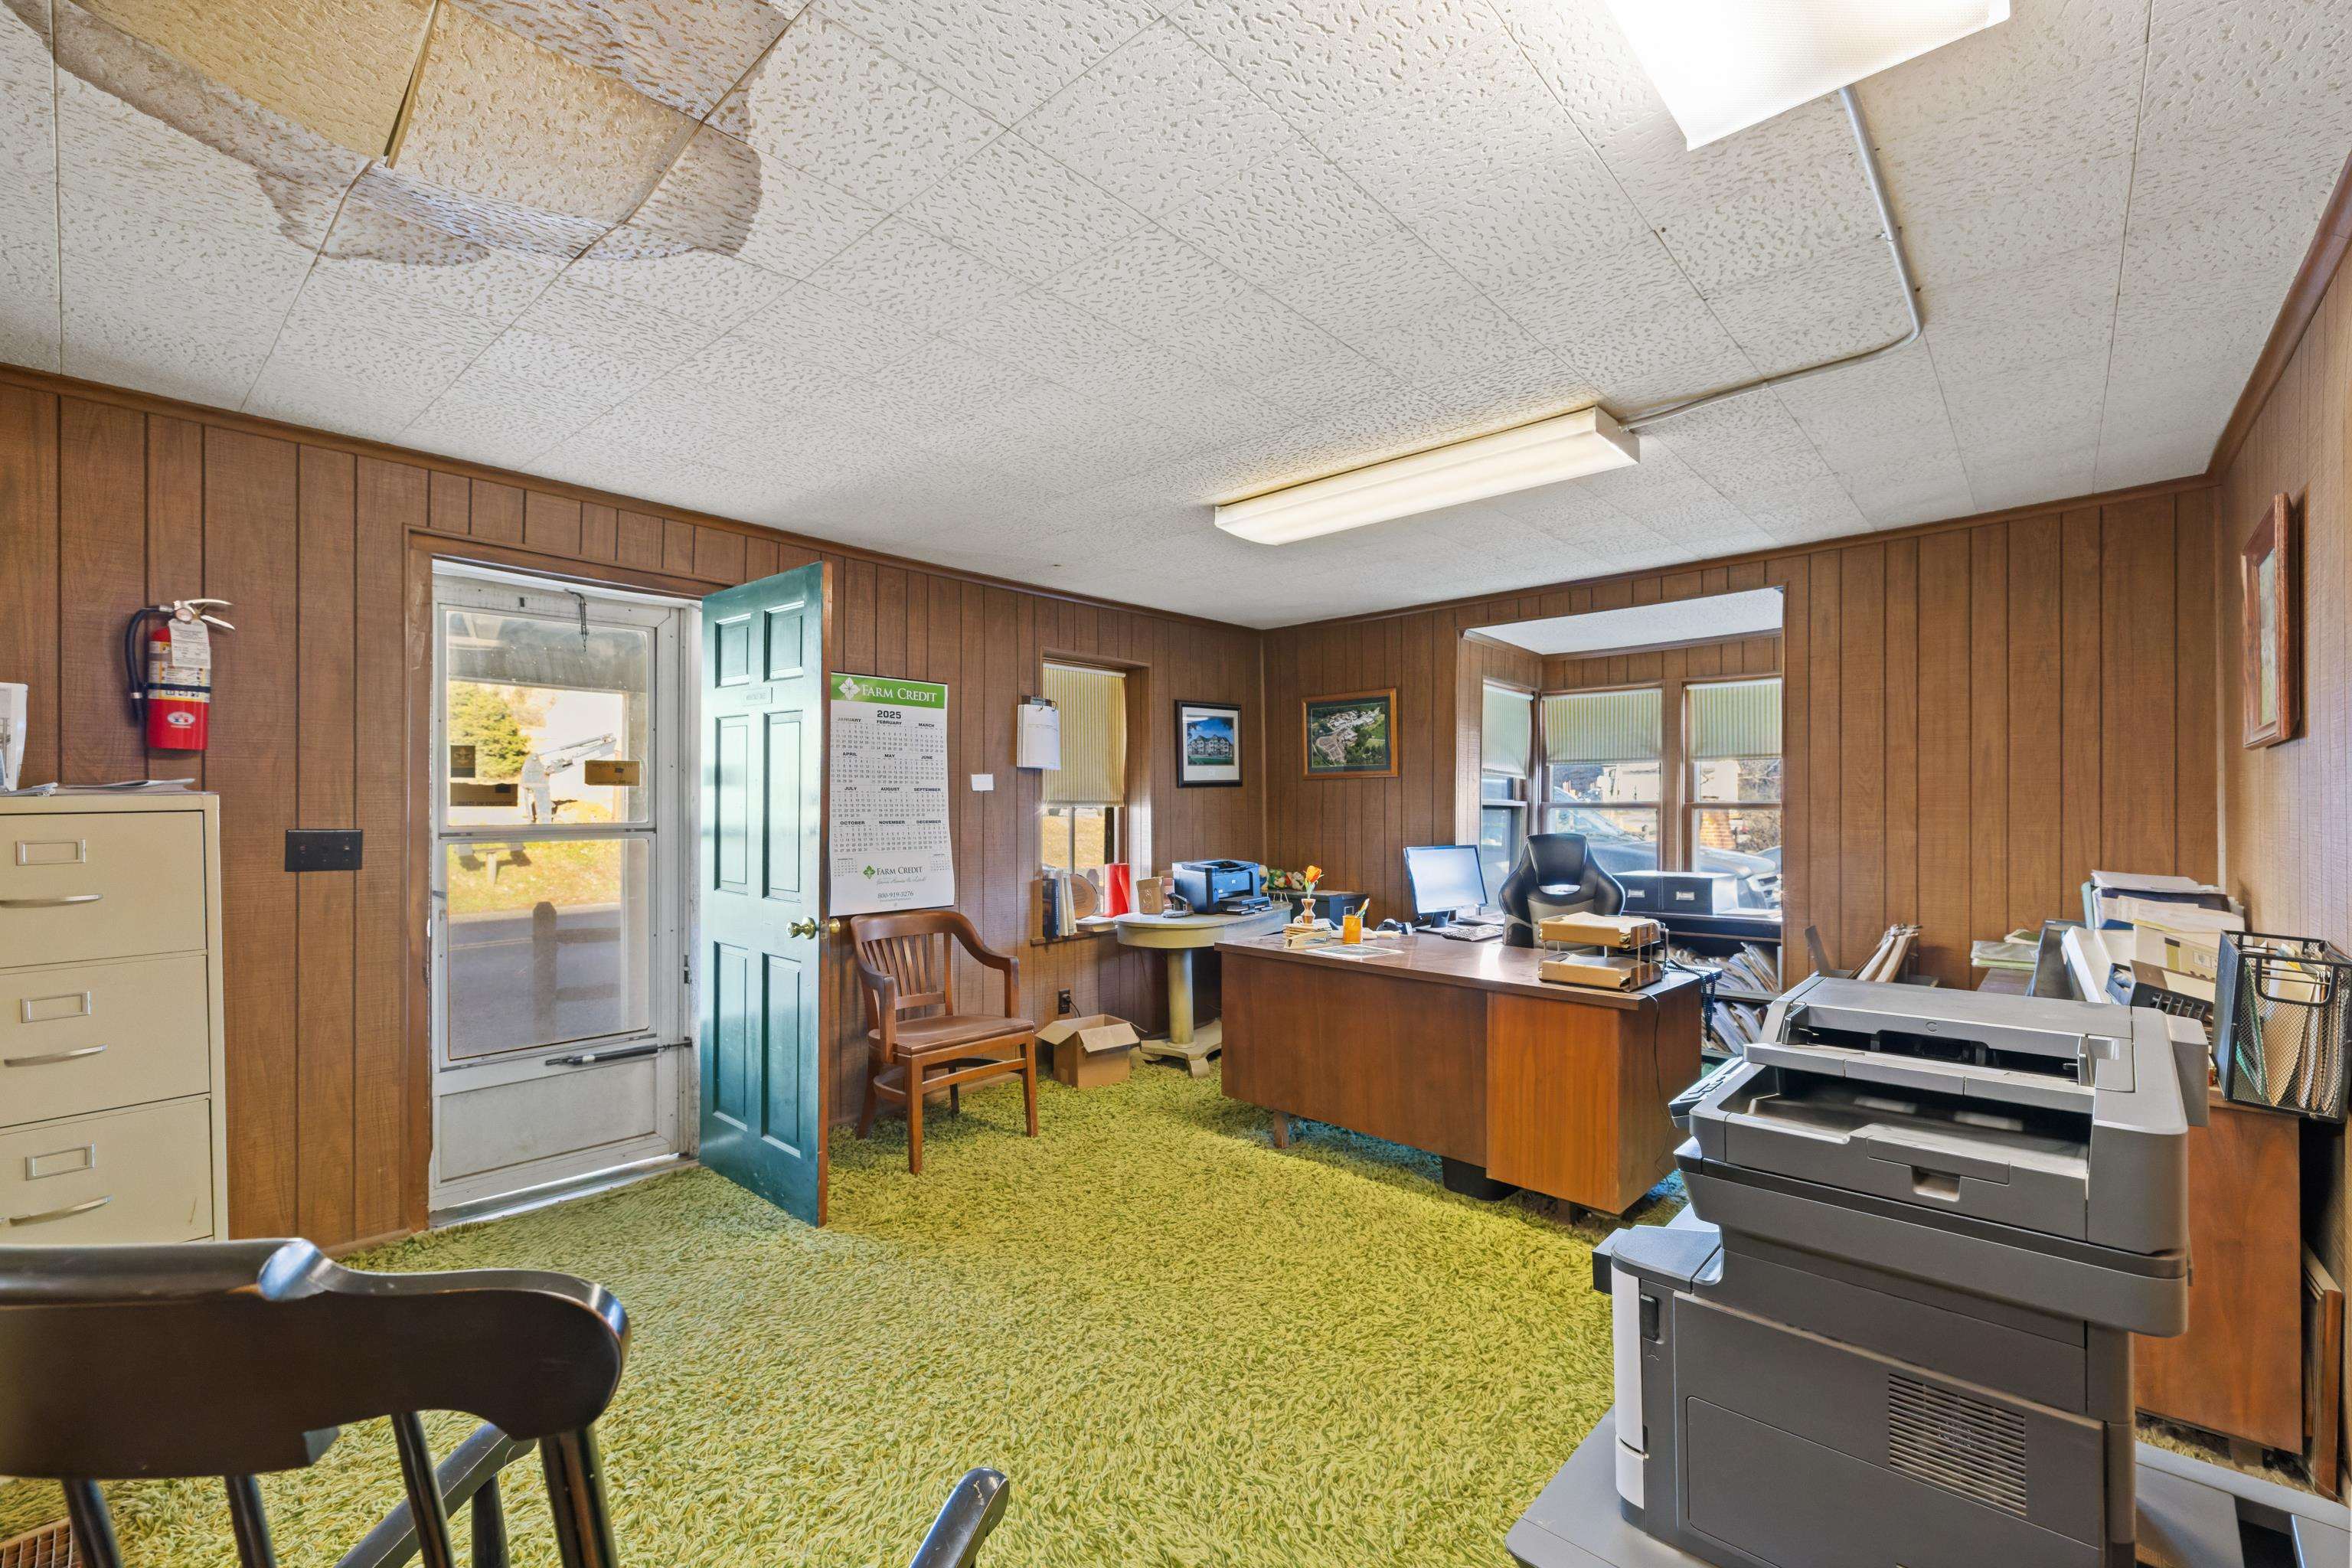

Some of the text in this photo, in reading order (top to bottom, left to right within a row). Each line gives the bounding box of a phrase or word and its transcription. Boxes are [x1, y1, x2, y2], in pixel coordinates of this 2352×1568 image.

[861, 684, 938, 702] FARM CREDIT
[877, 710, 902, 719] 2025
[877, 866, 923, 876] FARM CREDIT
